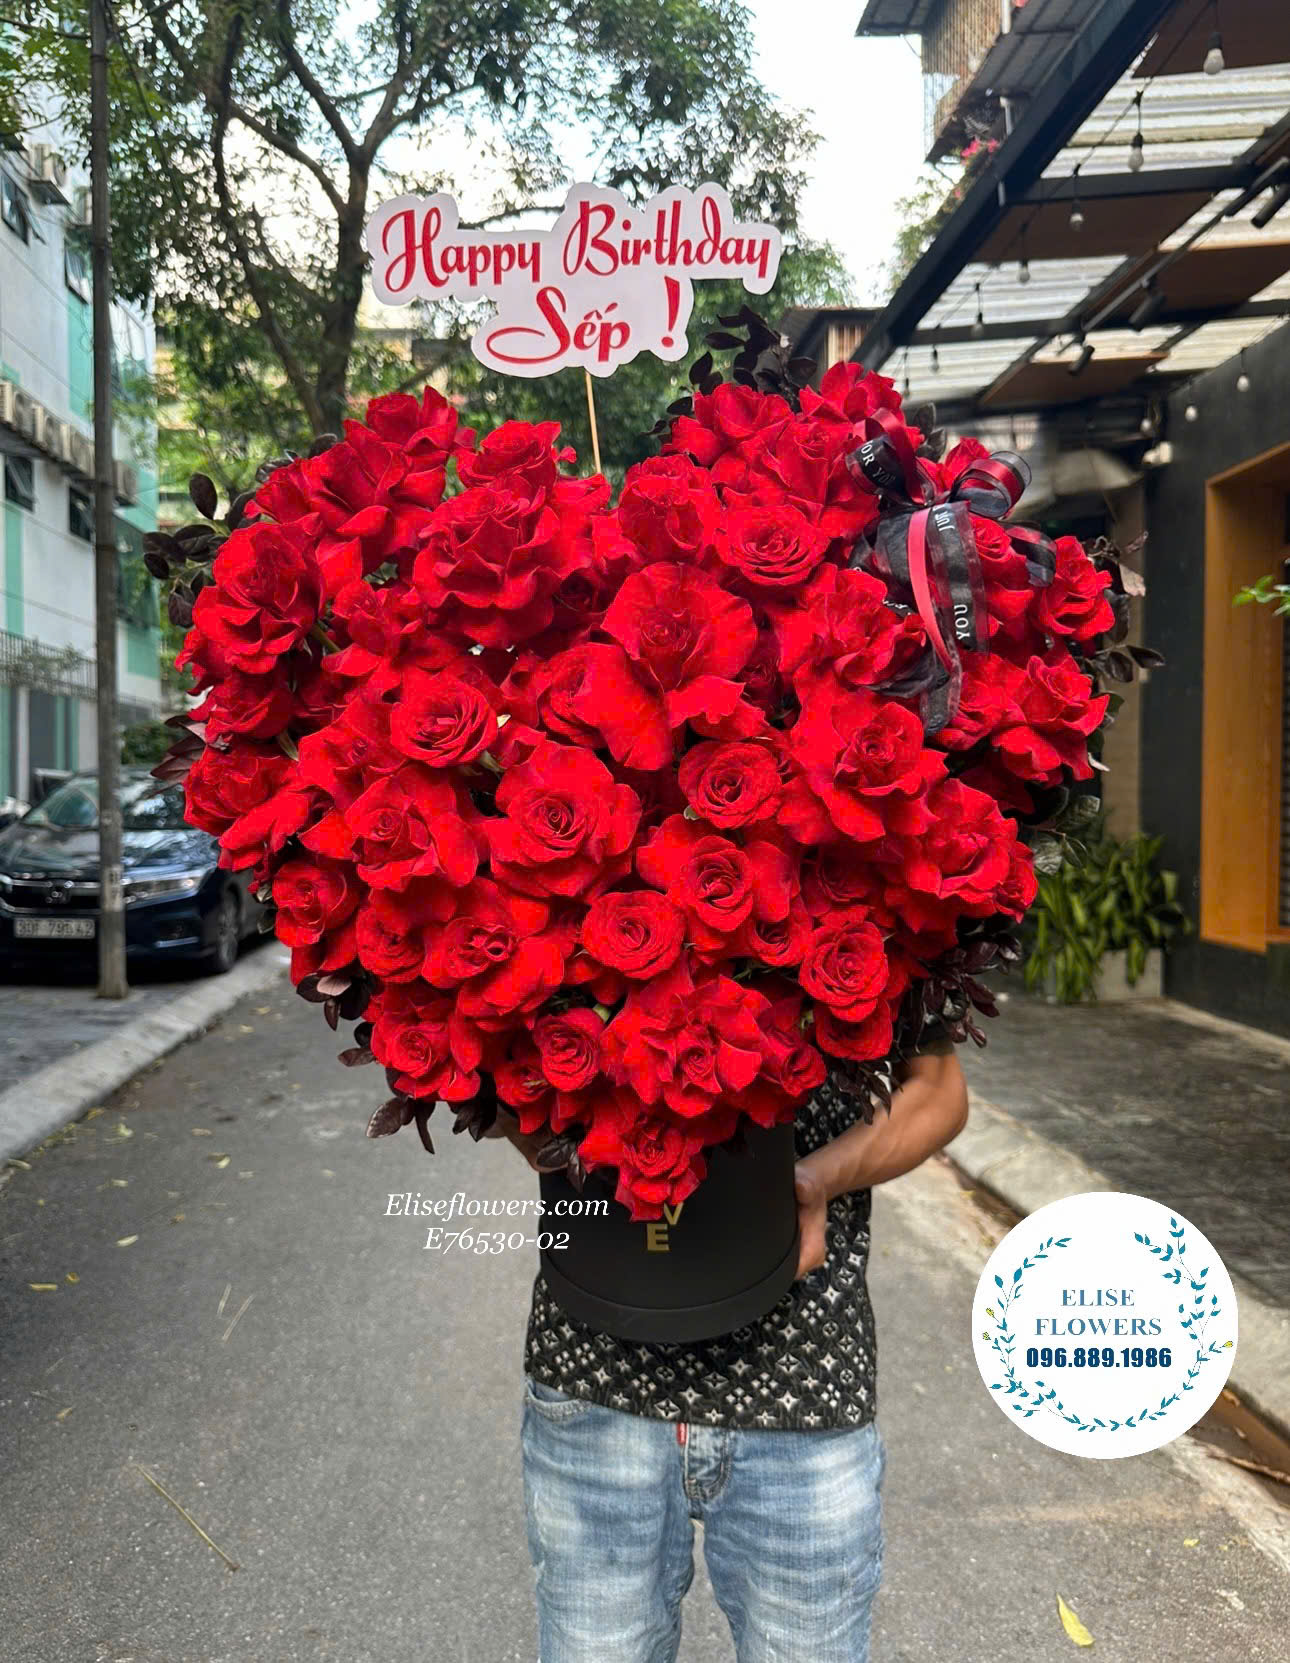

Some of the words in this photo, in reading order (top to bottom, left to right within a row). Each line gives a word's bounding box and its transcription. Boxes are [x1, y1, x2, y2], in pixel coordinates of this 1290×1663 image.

[381, 206, 542, 294] Happy
[562, 195, 771, 280] Birthday
[486, 286, 632, 365] Sếp
[953, 604, 970, 640] YOU
